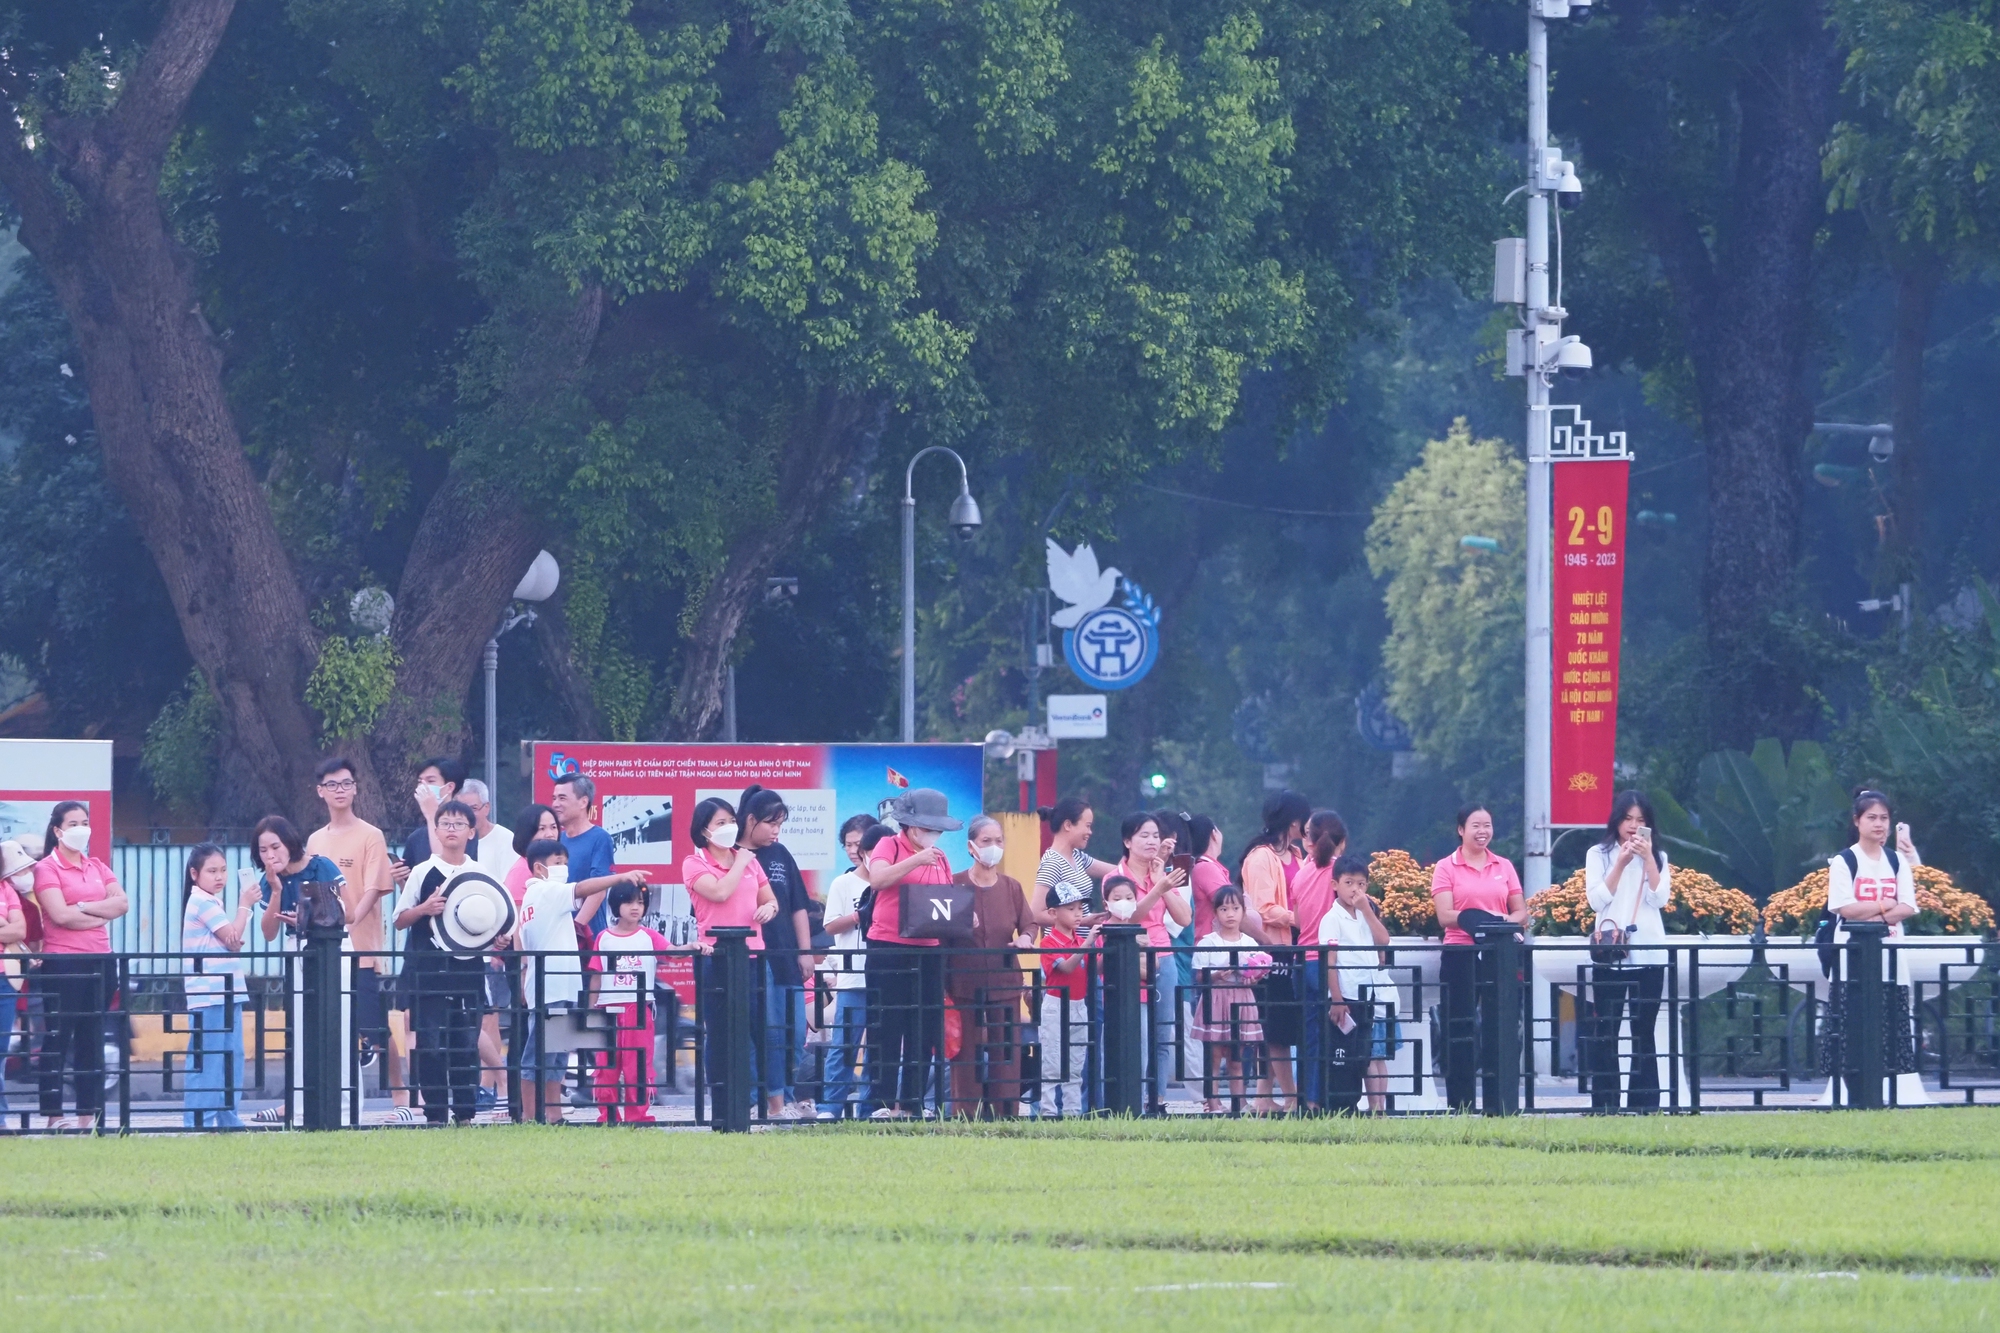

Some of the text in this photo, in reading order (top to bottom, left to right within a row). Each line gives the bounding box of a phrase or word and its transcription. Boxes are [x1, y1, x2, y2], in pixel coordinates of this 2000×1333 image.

[1568, 505, 1613, 545] 2-9
[1564, 553, 1588, 566] 1945
[1596, 552, 1616, 566] 2023
[1572, 590, 1607, 608] NHIỆT LIỆT
[1569, 610, 1590, 625] CHÀO
[1576, 632, 1587, 645] 78
[1568, 648, 1588, 665] QUỐC
[1570, 708, 1585, 725] VIỆT
[582, 759, 597, 768] HIỆP
[634, 758, 642, 767] VỀ
[643, 758, 661, 767] CHẤM
[677, 758, 696, 767] CHIẾN
[720, 759, 732, 768] LẬP
[733, 760, 743, 769] LẠI
[759, 759, 774, 767] BÌNH
[782, 759, 795, 768] VIỆT
[613, 768, 634, 777] THẮNG
[636, 770, 646, 778] LỢI
[648, 769, 664, 777] TRÊN
[665, 769, 678, 779] MẶT
[679, 769, 695, 779] TRẬN
[697, 770, 716, 779] NGOẠI
[734, 769, 749, 777] THỜI
[761, 769, 771, 777] HỒ
[929, 898, 953, 921] N
